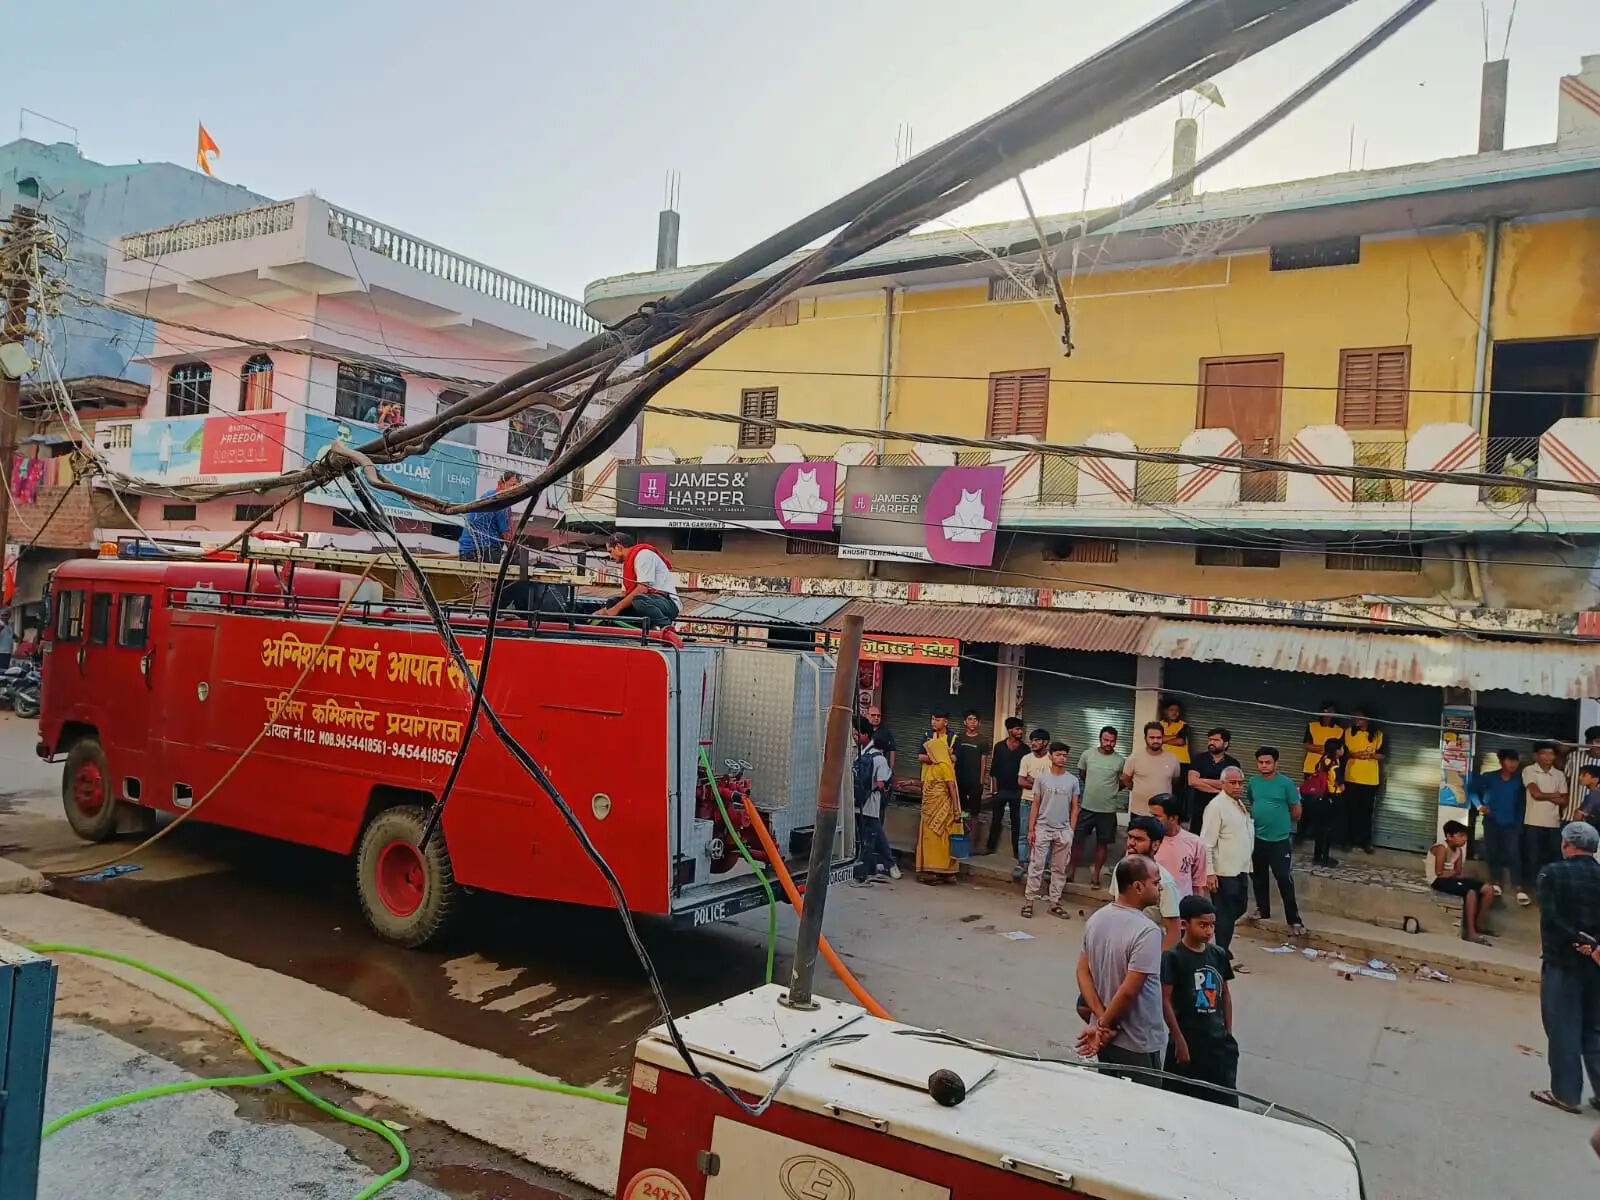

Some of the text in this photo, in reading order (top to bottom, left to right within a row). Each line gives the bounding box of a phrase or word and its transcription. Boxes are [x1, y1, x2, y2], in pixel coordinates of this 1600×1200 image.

[221, 432, 264, 445] FREEDOM
[384, 463, 430, 480] DOLLAR
[447, 473, 472, 486] LEHAR
[669, 472, 745, 487] JAMES &
[668, 490, 745, 506] HARPER
[871, 494, 910, 503] JAMES
[910, 494, 920, 504] &
[870, 504, 919, 514] HARPER
[842, 548, 867, 556] KHUSHI
[262, 632, 346, 675] अग्निशमन
[349, 641, 382, 681] एवं
[387, 651, 446, 687] आपात
[386, 712, 465, 744] प्रयागराज
[694, 902, 727, 927] POLICE
